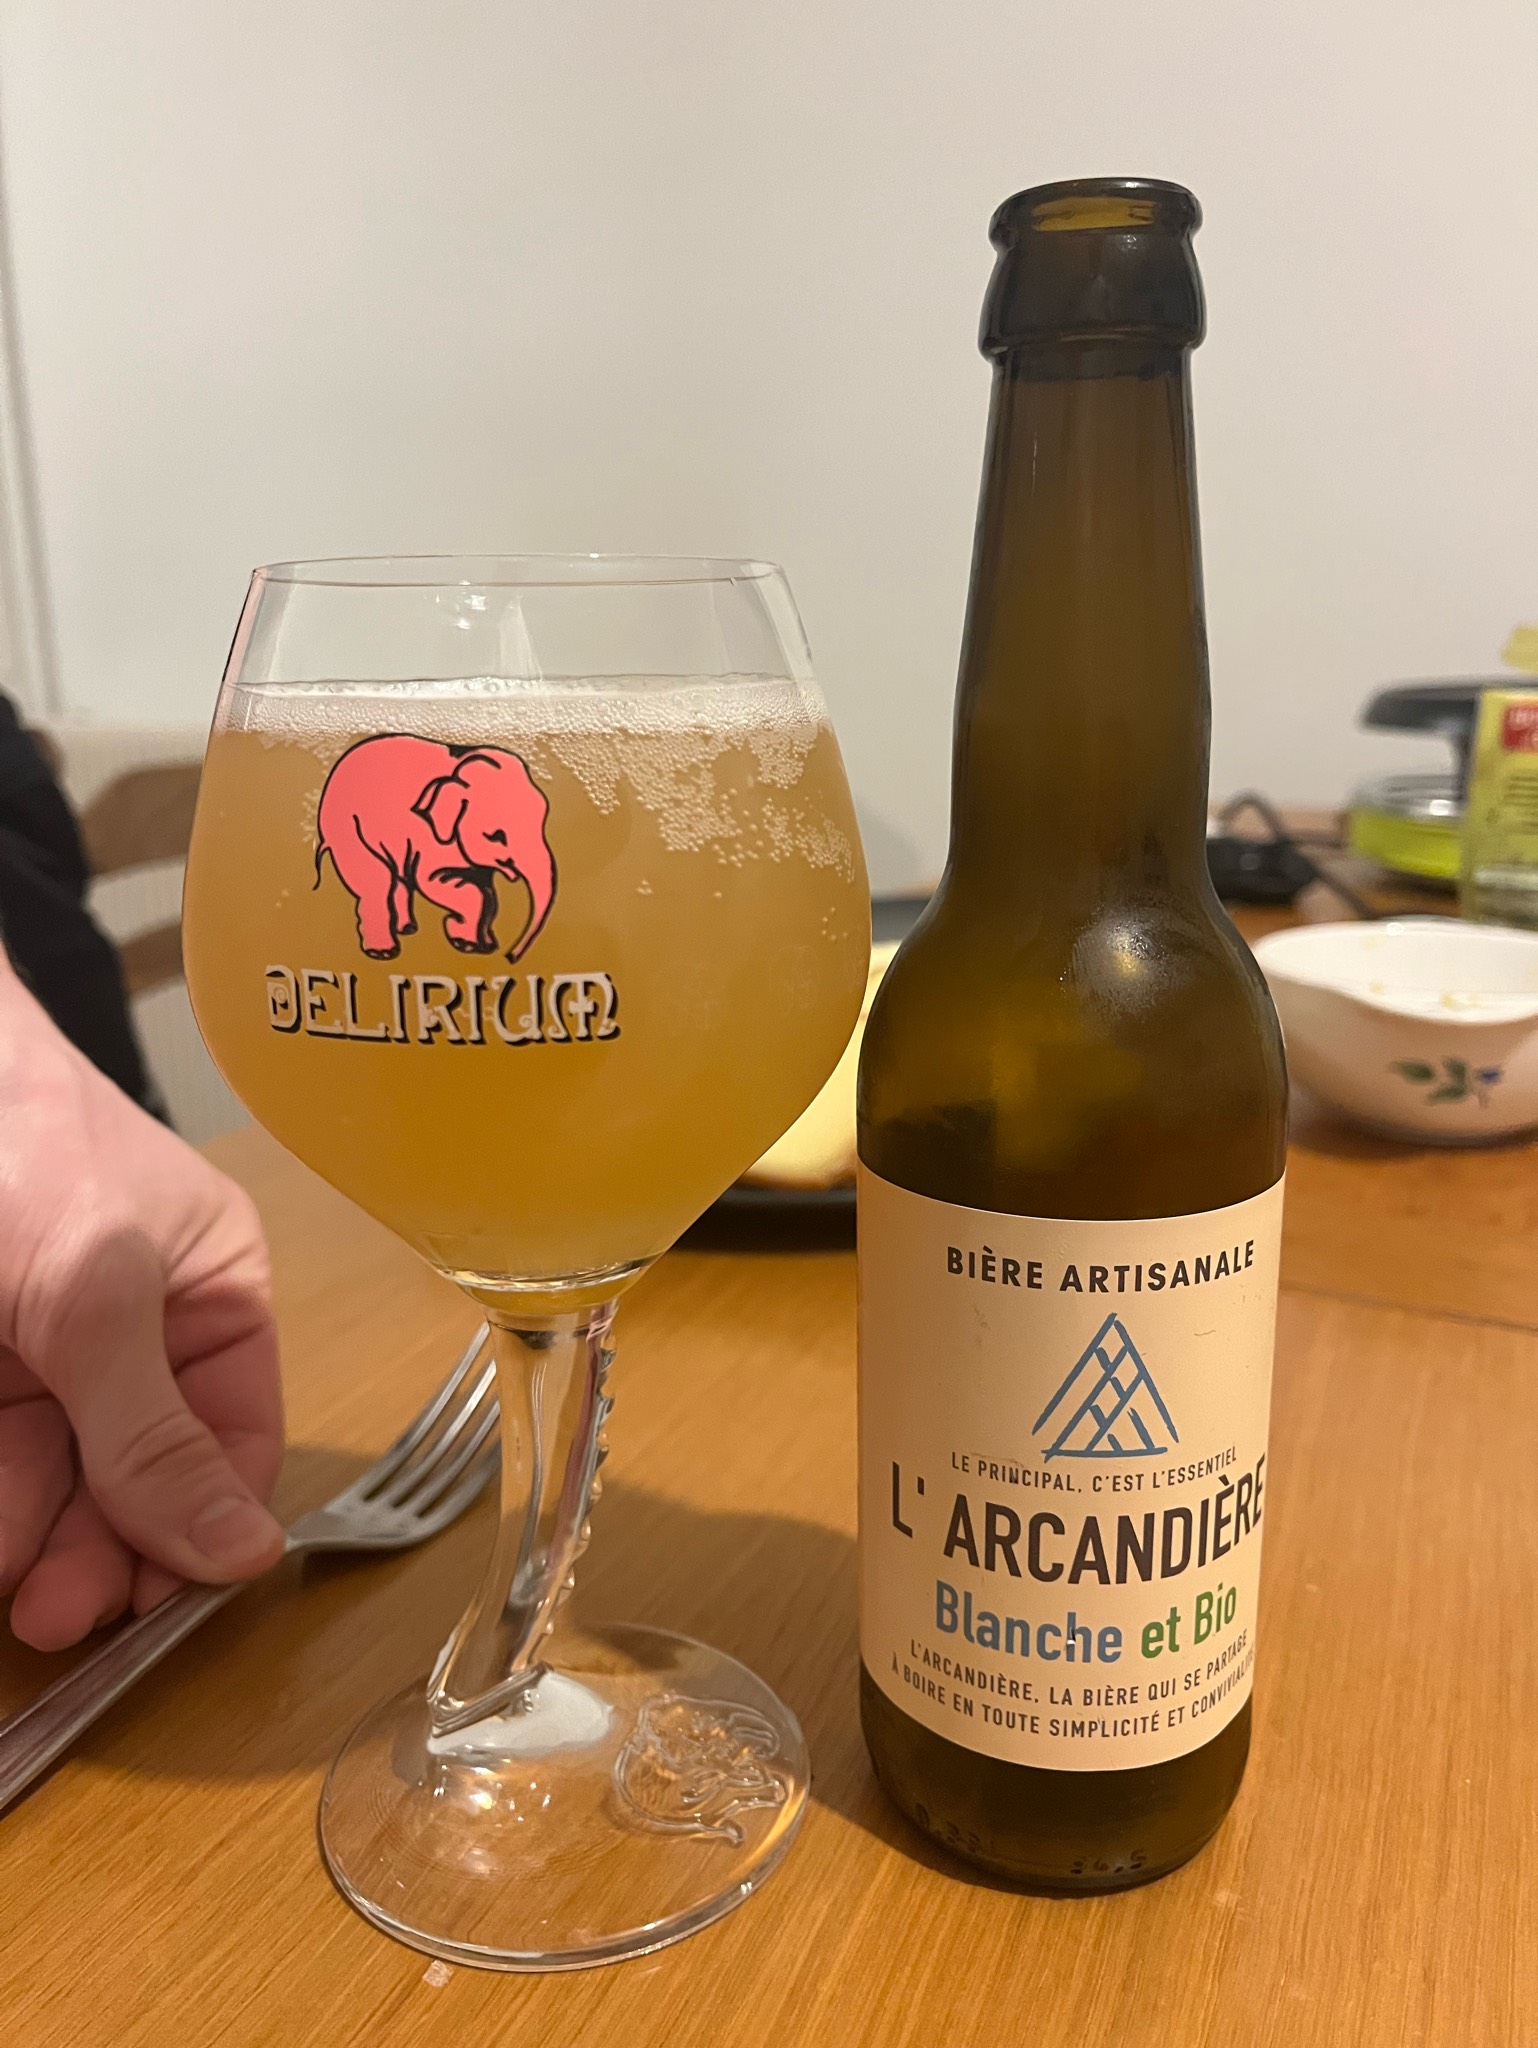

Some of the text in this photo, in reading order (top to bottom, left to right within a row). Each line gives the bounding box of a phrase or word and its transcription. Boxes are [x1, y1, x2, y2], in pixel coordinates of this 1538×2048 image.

[265, 964, 622, 1047] DELIRIUM
[947, 1239, 1256, 1294] BIÈRE ARTISANALE
[952, 1445, 1237, 1494] LE PRINCIPAL, C'EST L'ESSENTIEL
[943, 1452, 1266, 1586] ARCANDIÈRE
[936, 1579, 1237, 1664] Blanche et Bio
[903, 1665, 947, 1707] BOIRE
[953, 1692, 975, 1718] EN
[982, 1703, 1041, 1736] TOUTE
[1049, 1709, 1161, 1739] SIMPLICITÉ
[1167, 1706, 1186, 1728] ET
[911, 1628, 1248, 1707] L'ARCANDIÈRE, LA BIÈRE QUI SE PARTAGE
